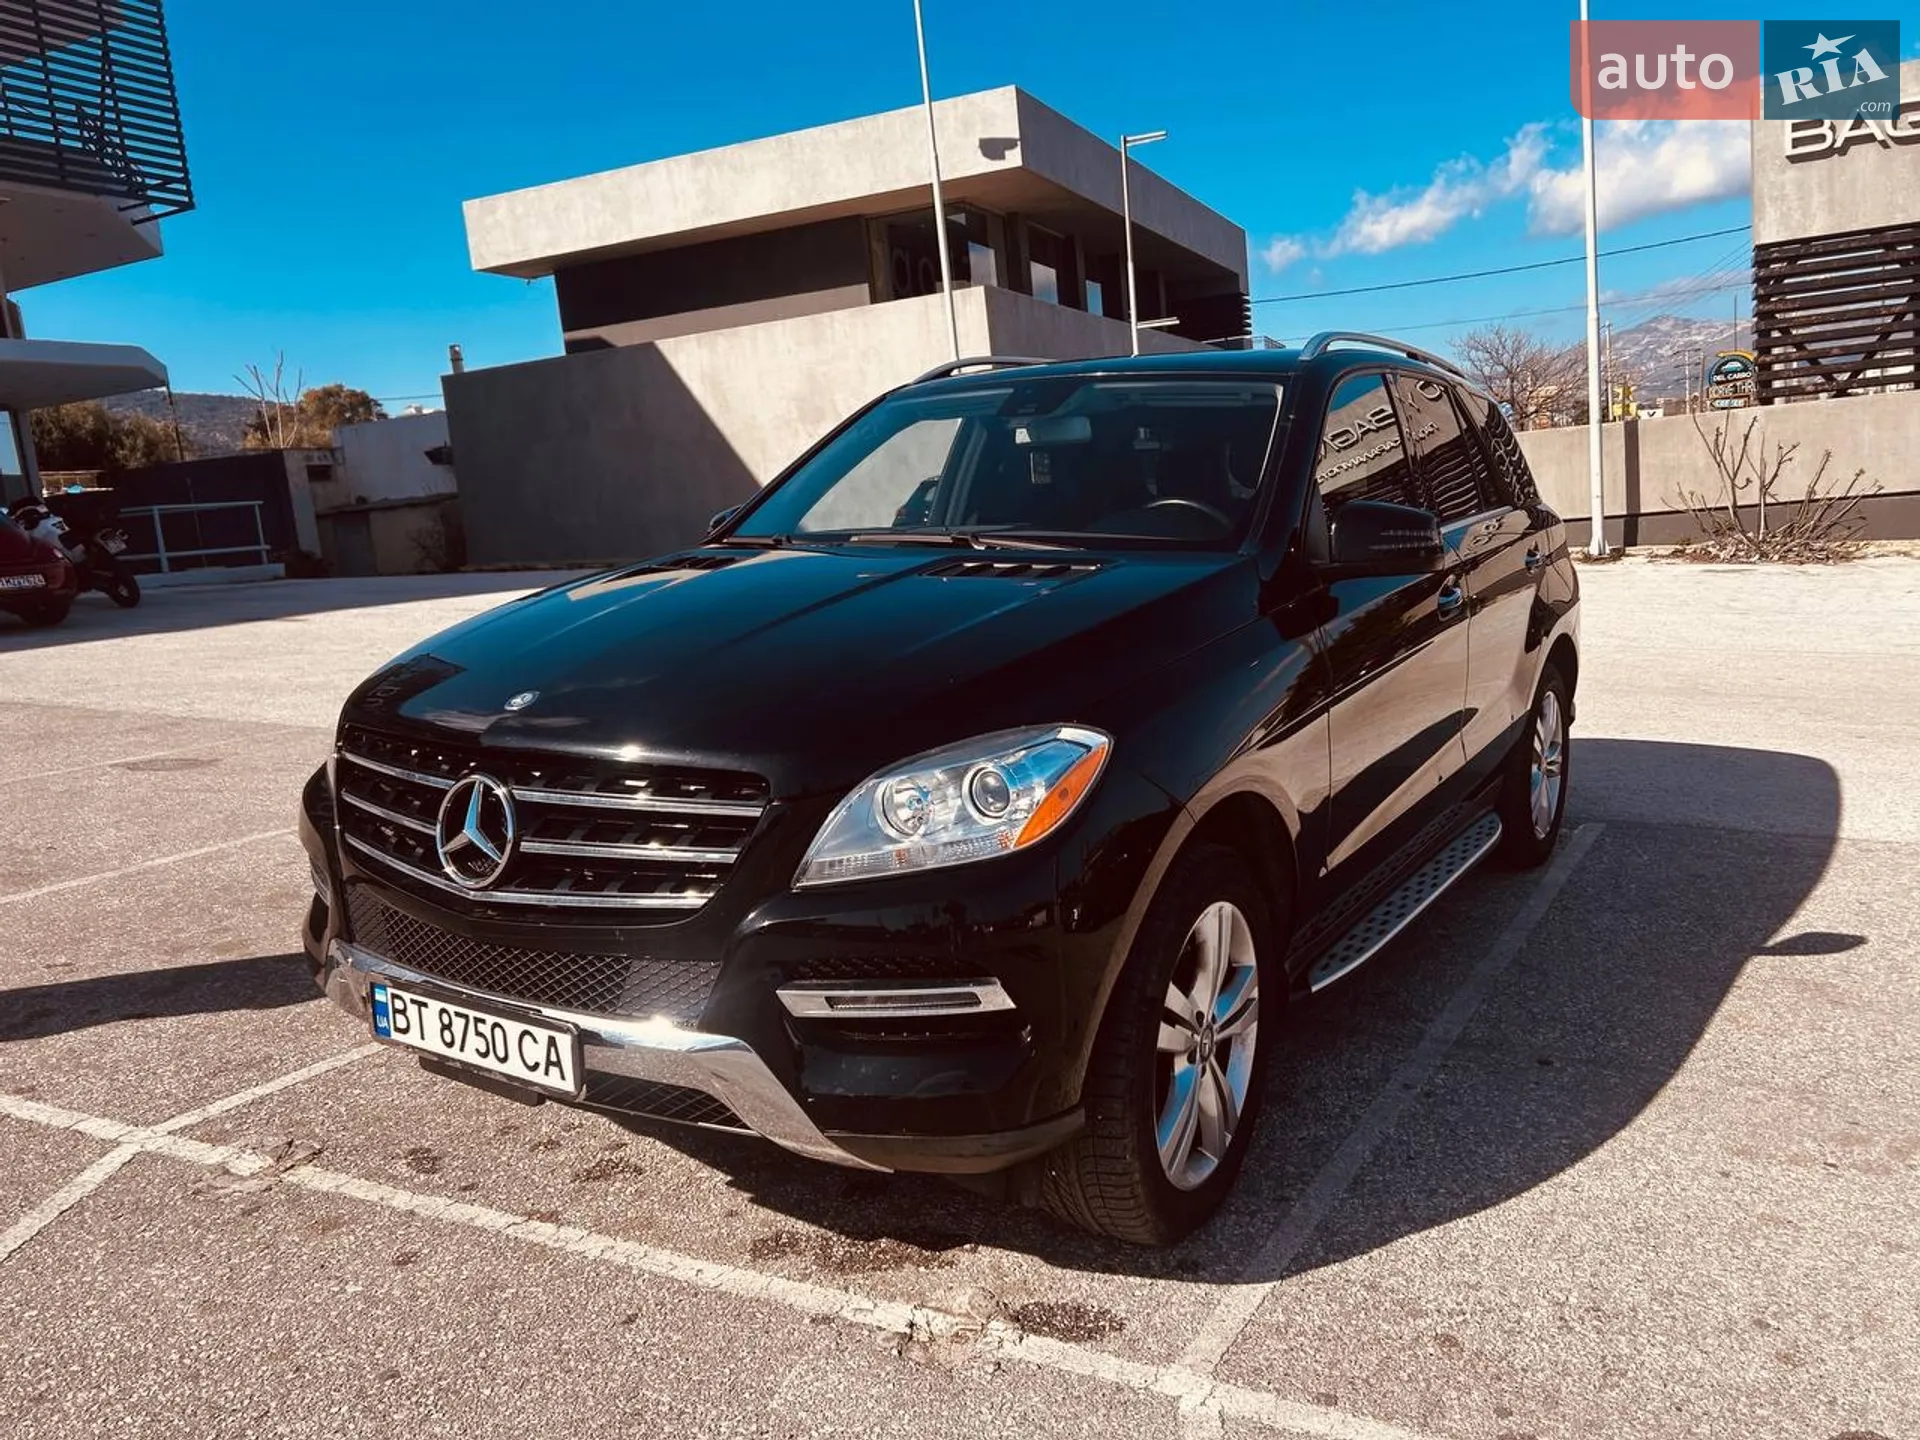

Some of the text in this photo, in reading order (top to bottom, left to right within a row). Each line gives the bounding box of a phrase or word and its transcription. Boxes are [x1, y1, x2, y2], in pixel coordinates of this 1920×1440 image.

[376, 1014, 389, 1029] UA
[390, 993, 566, 1081] BT 8750 CA
